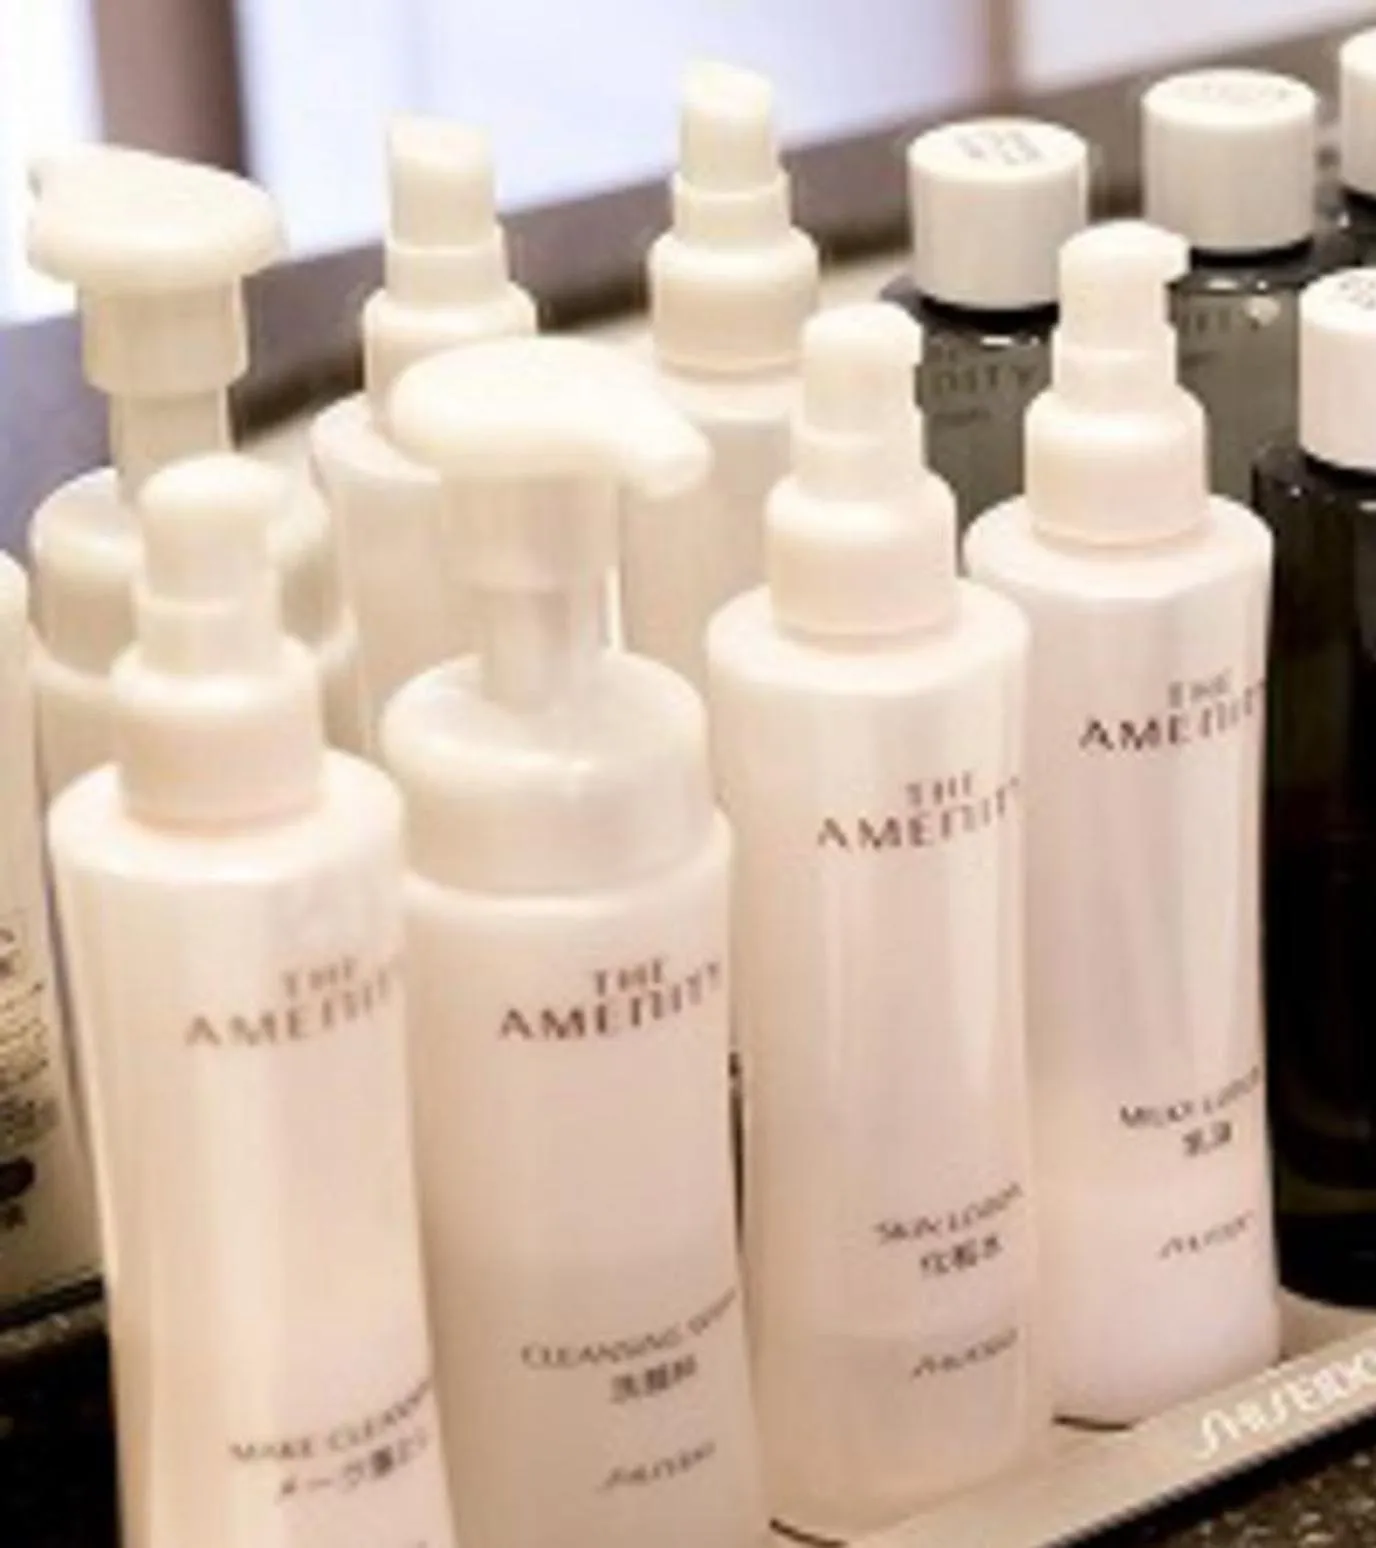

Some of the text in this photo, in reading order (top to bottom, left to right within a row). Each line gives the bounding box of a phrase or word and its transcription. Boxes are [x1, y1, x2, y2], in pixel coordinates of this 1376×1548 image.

[1168, 668, 1231, 708] THE
[905, 769, 972, 806] THE
[282, 957, 357, 1000] THE
[592, 957, 662, 998] THE
